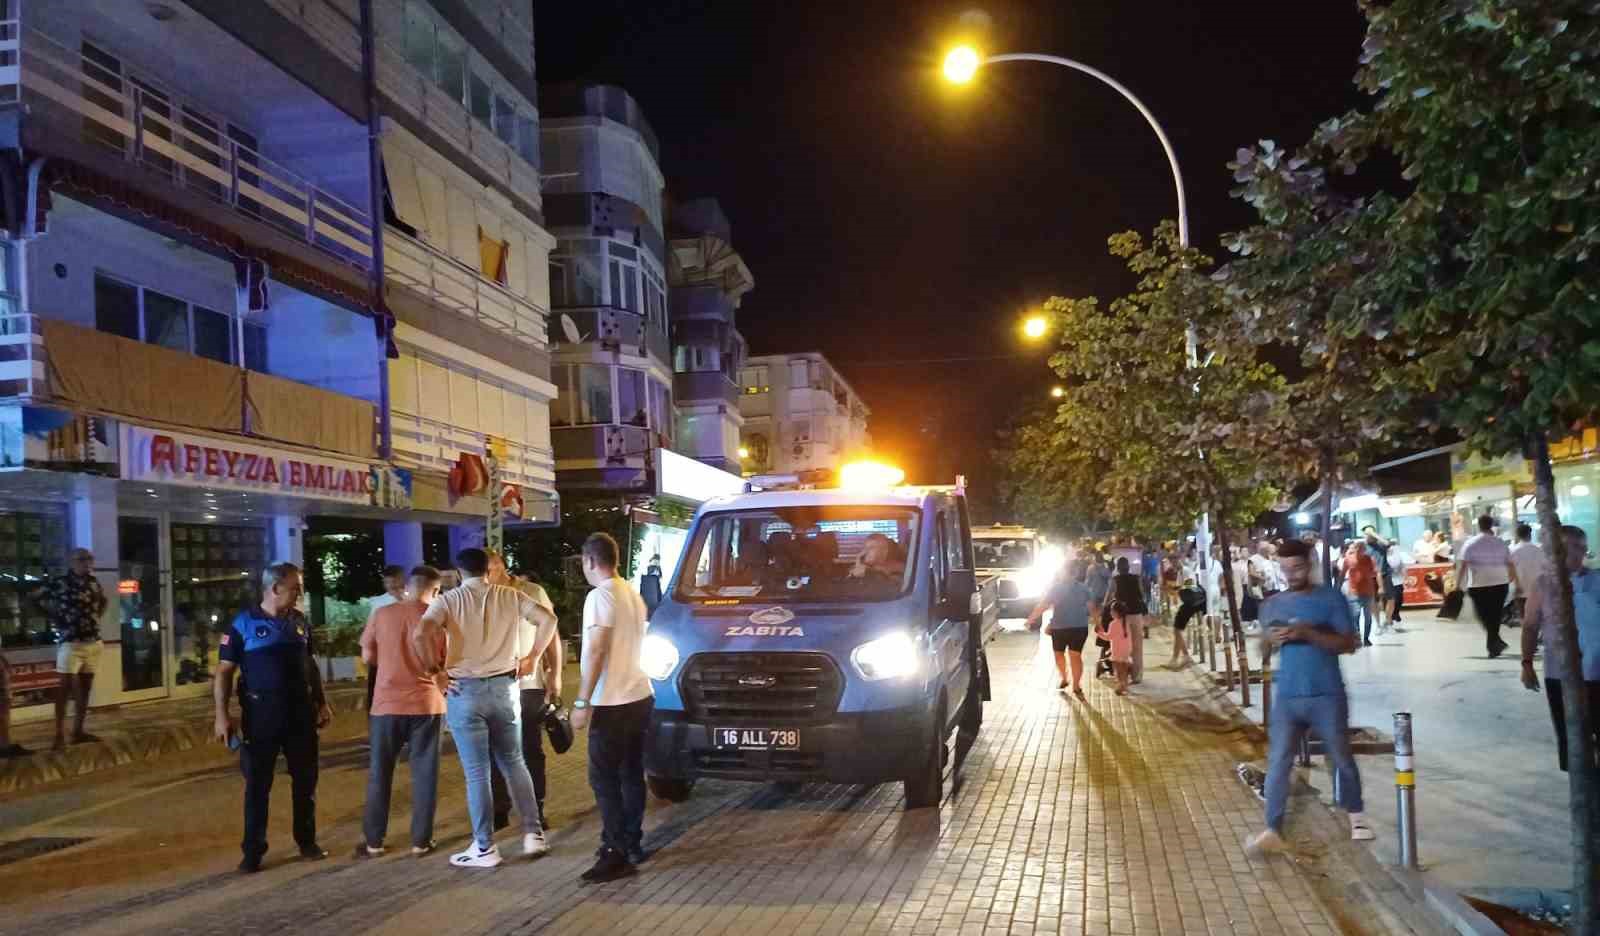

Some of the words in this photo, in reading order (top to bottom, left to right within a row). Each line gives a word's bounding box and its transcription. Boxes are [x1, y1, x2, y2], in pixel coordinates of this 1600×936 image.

[184, 444, 279, 484] FEYZA
[288, 460, 373, 494] EMLAK
[725, 626, 805, 637] ZABITA
[724, 730, 738, 745] 16
[741, 731, 767, 745] ALL
[770, 731, 797, 745] 738
